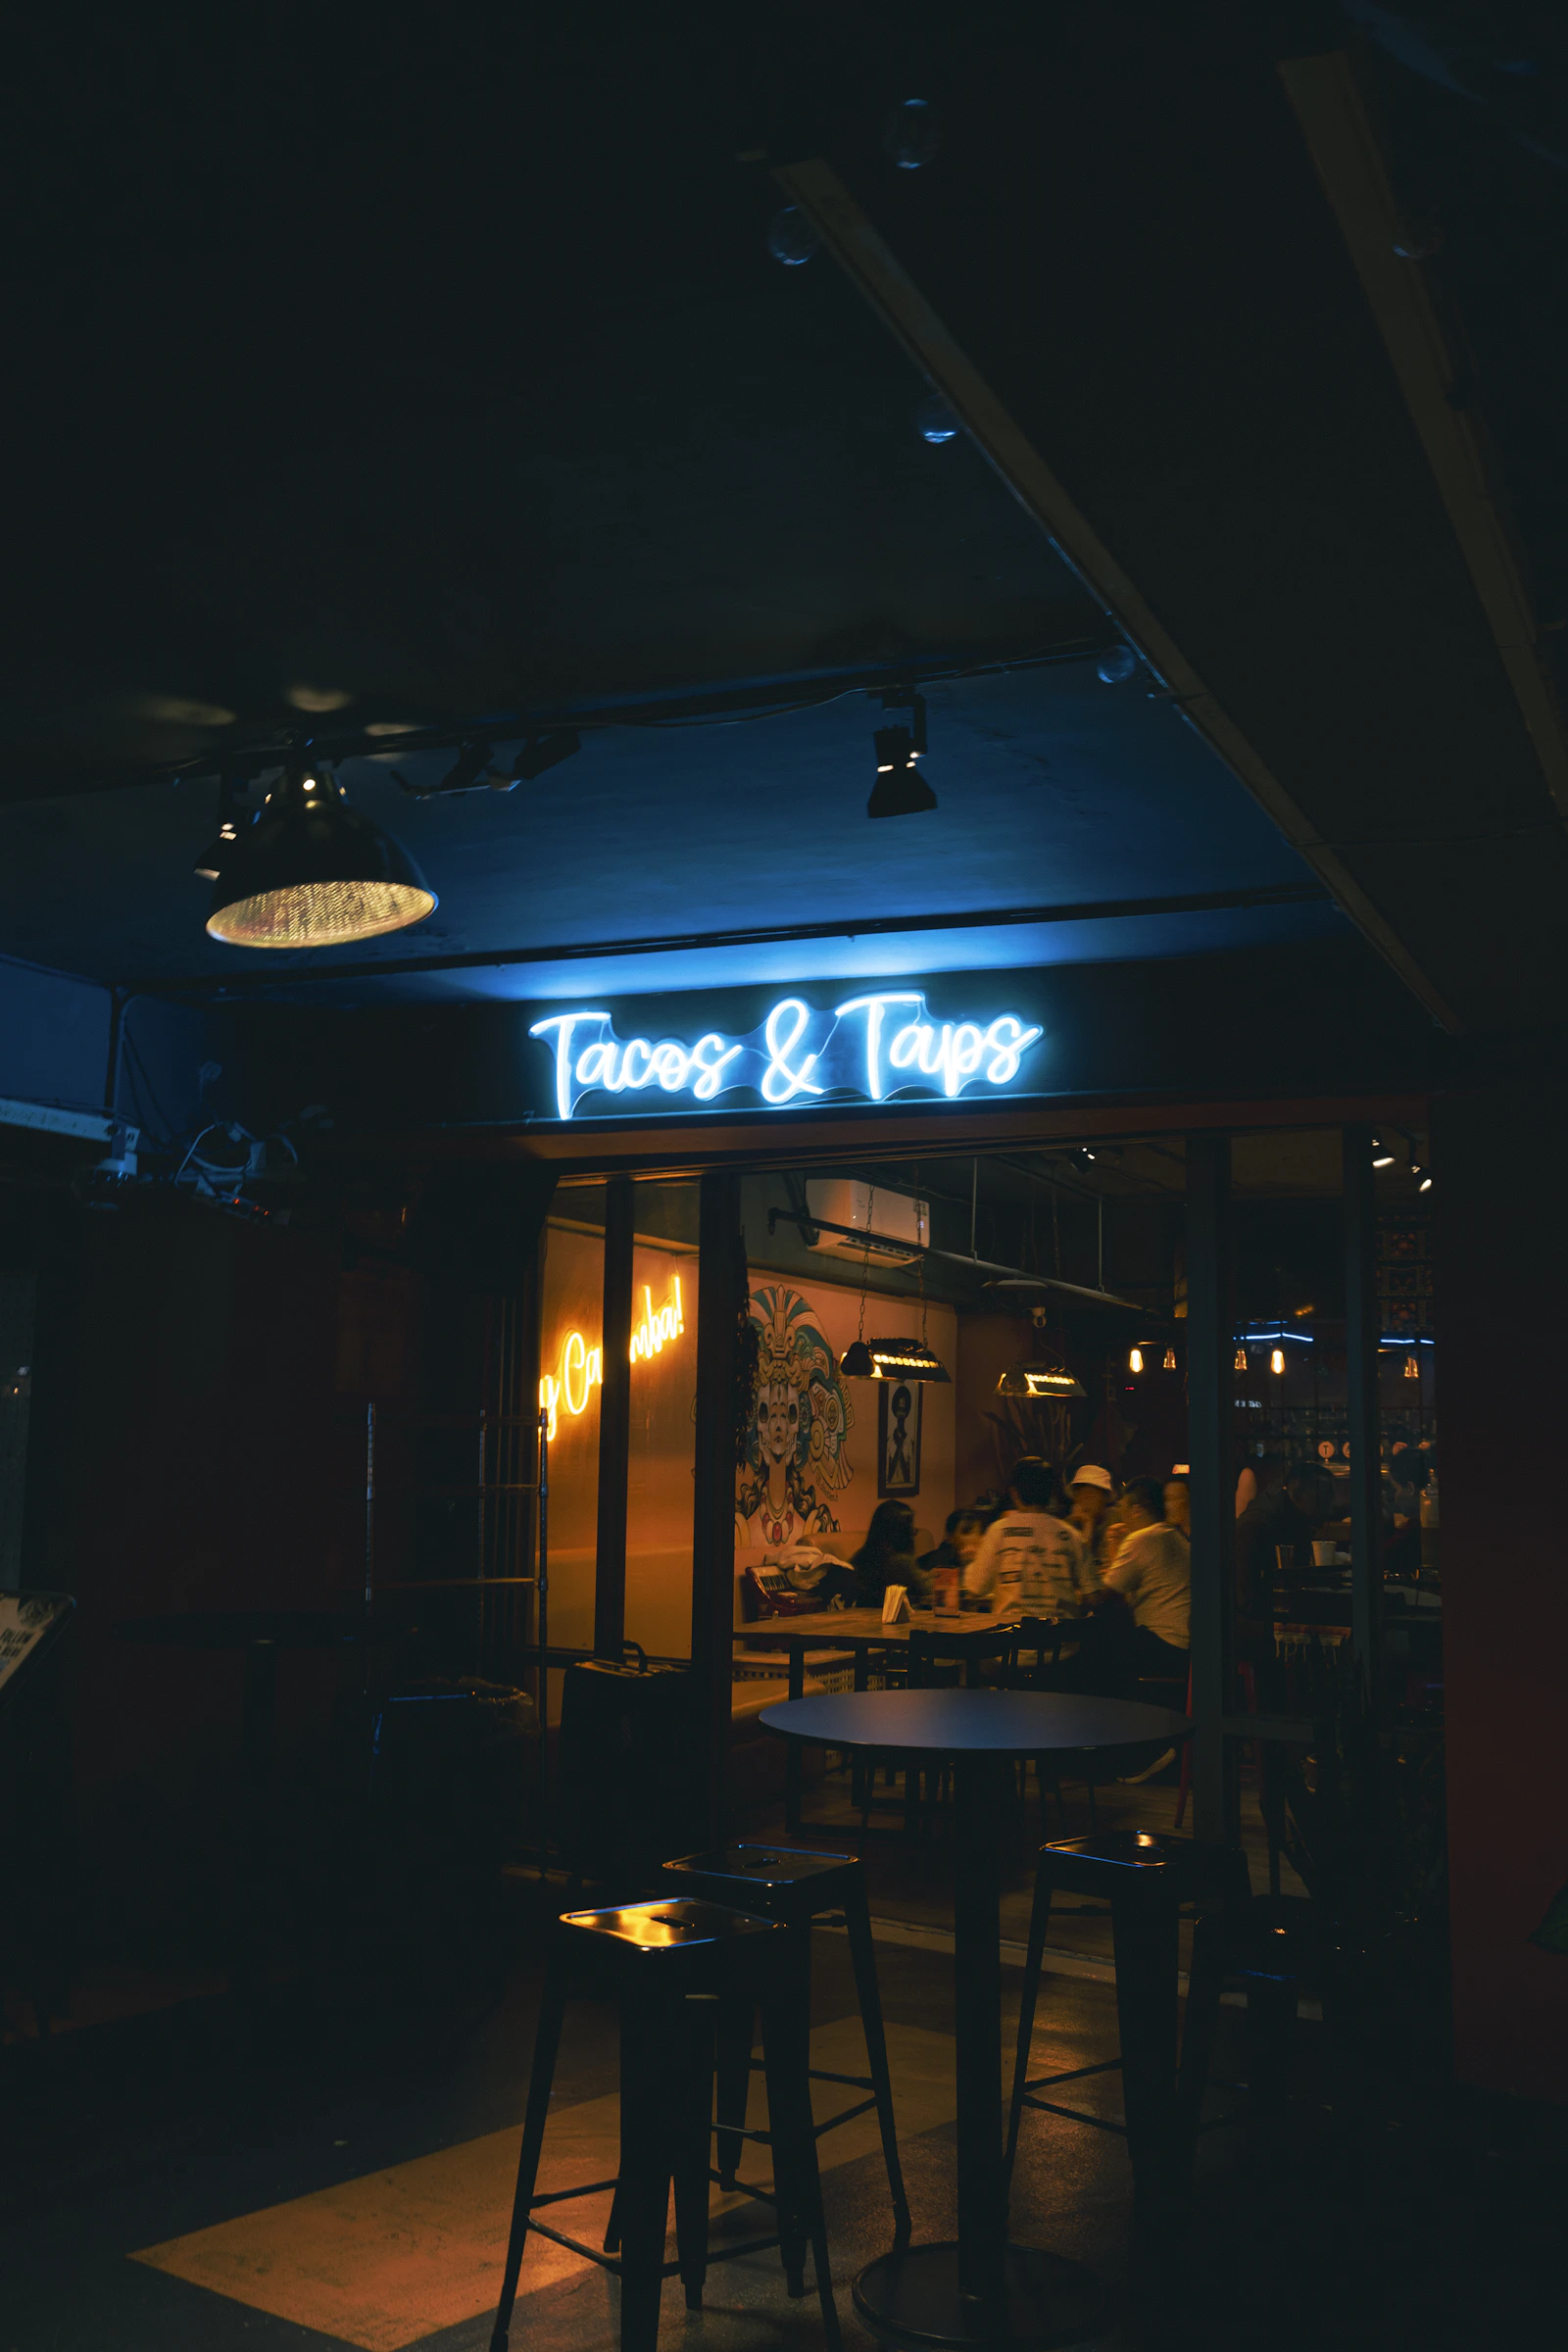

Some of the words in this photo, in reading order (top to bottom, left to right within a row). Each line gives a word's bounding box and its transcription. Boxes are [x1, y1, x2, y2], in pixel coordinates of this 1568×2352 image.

[529, 1011, 743, 1121] Tacos
[761, 997, 824, 1104] &
[834, 993, 1043, 1100] Taps
